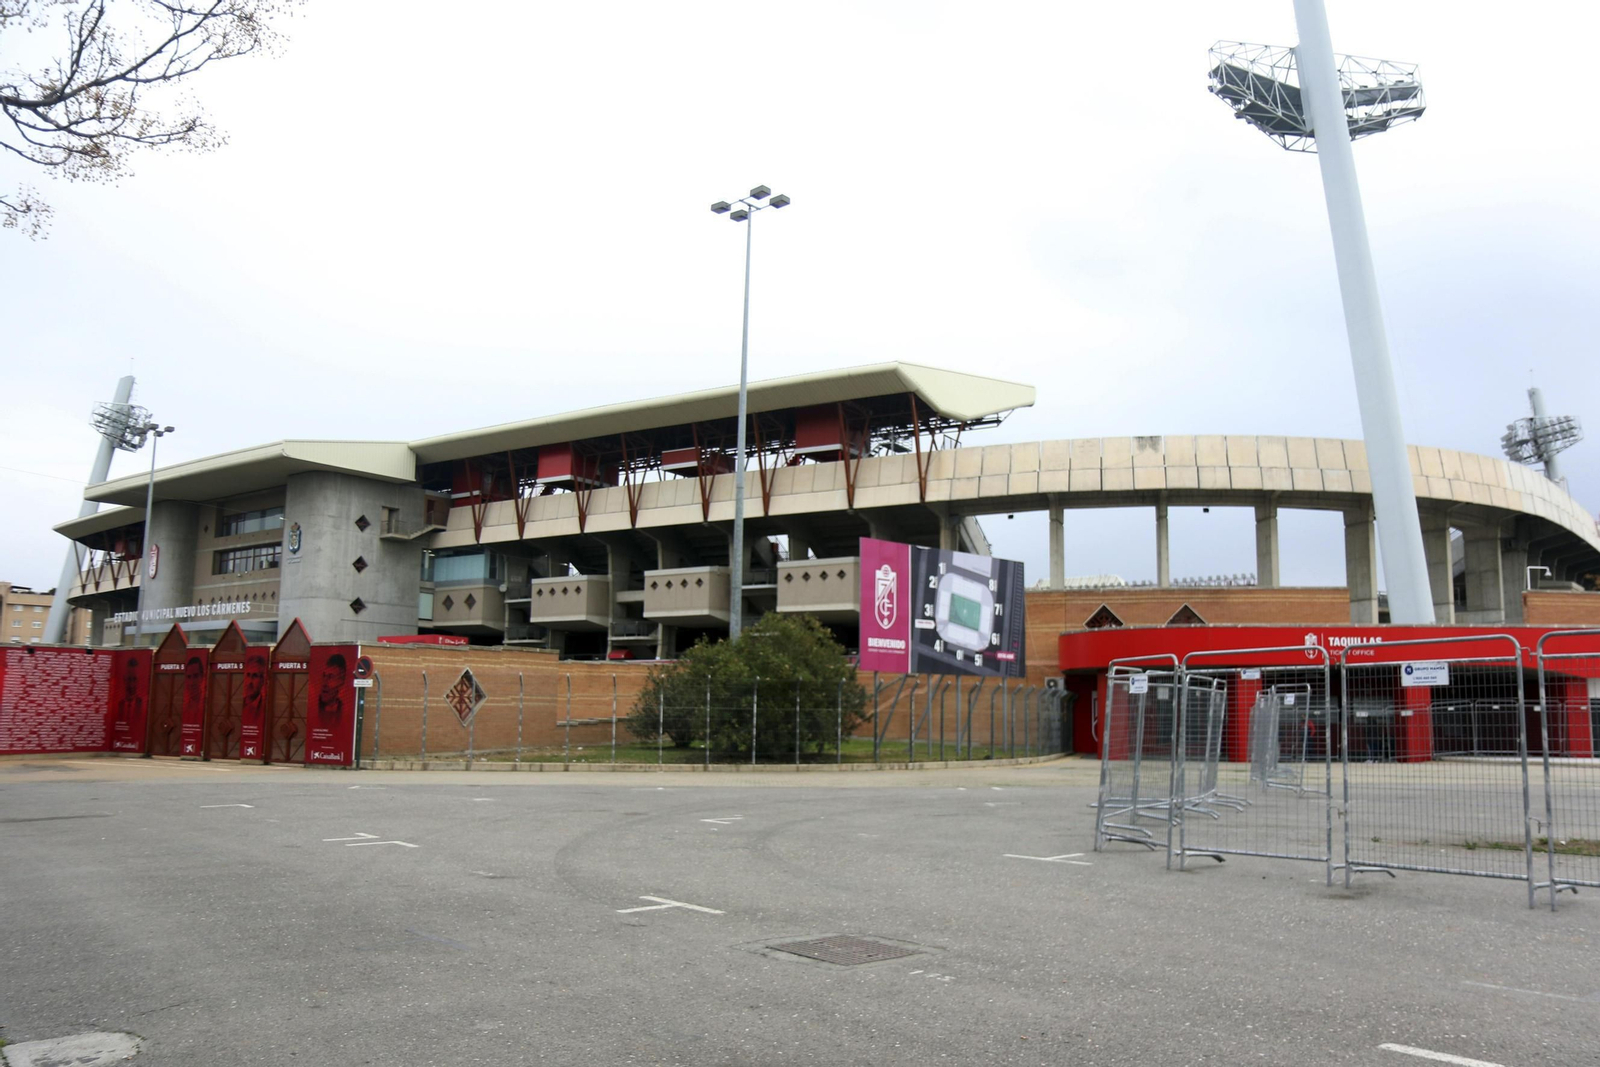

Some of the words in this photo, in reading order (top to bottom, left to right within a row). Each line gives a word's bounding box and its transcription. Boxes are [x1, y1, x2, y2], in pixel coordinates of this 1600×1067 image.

[175, 606, 196, 618] NUEVO
[197, 604, 210, 616] LOS
[211, 601, 251, 616] CÁRMENES
[1328, 636, 1382, 648] TAQUILLAS
